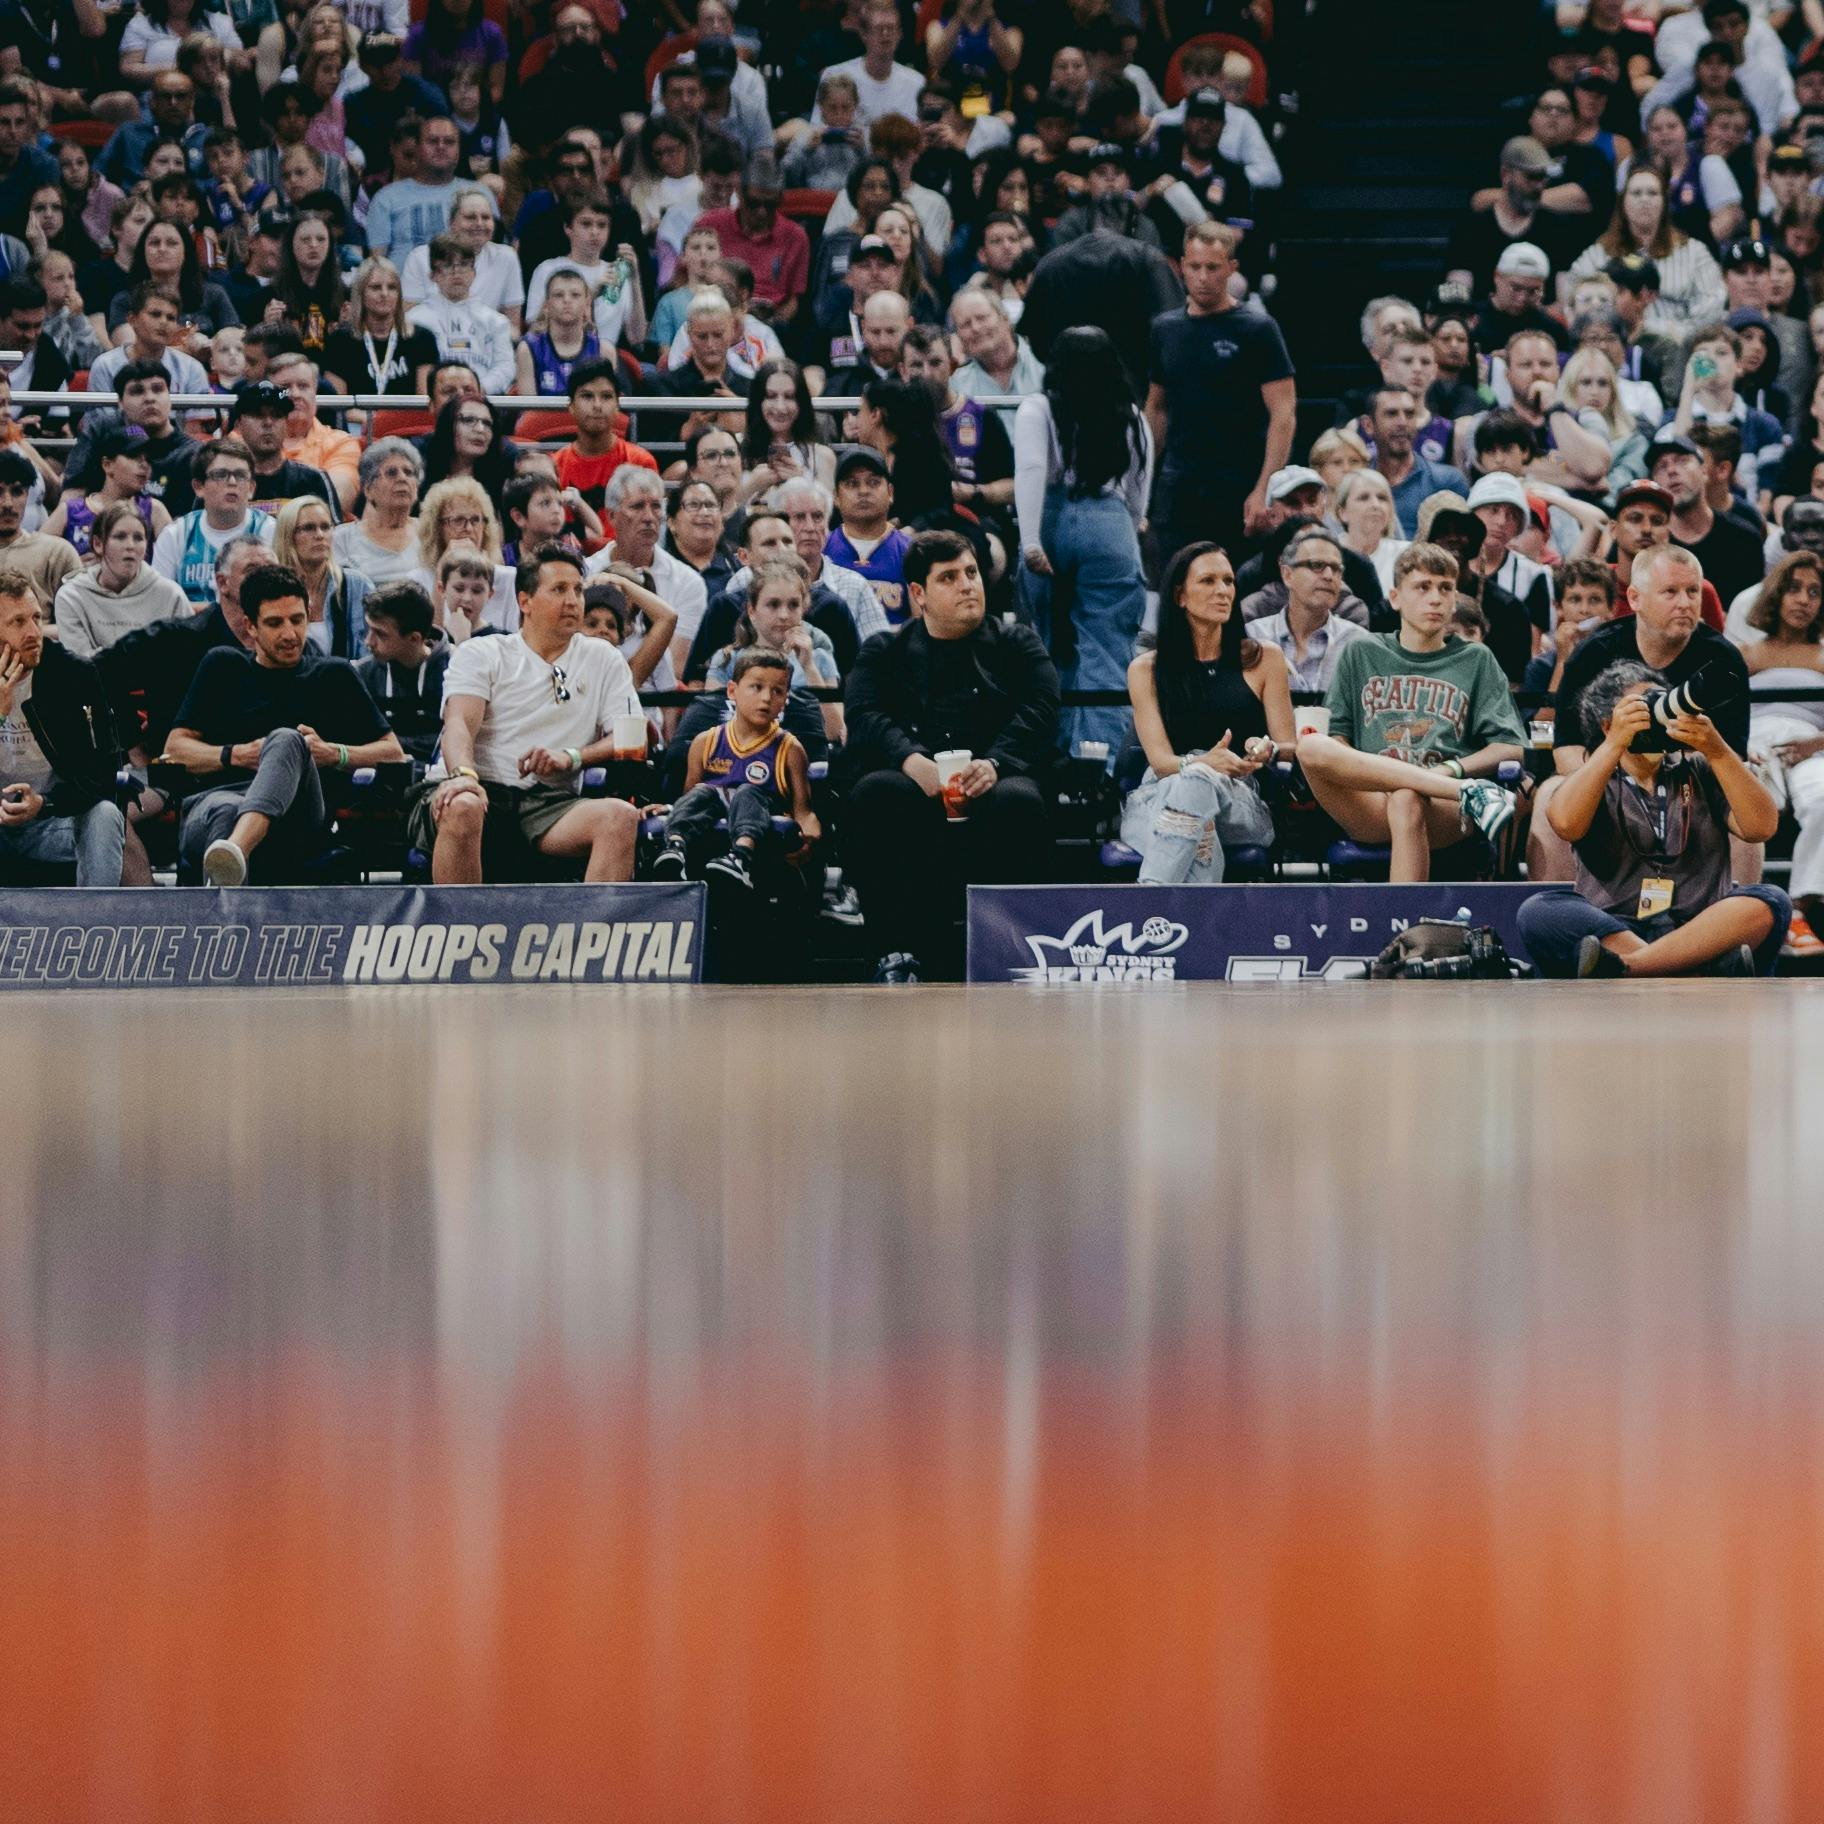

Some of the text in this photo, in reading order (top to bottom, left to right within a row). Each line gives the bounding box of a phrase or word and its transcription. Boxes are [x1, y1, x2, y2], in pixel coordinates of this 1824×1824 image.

[190, 926, 252, 980] TO
[257, 926, 346, 980] THE
[346, 923, 508, 980] HOOPS
[512, 921, 694, 979] CAPITAL
[1105, 955, 1176, 968] SYDNEY
